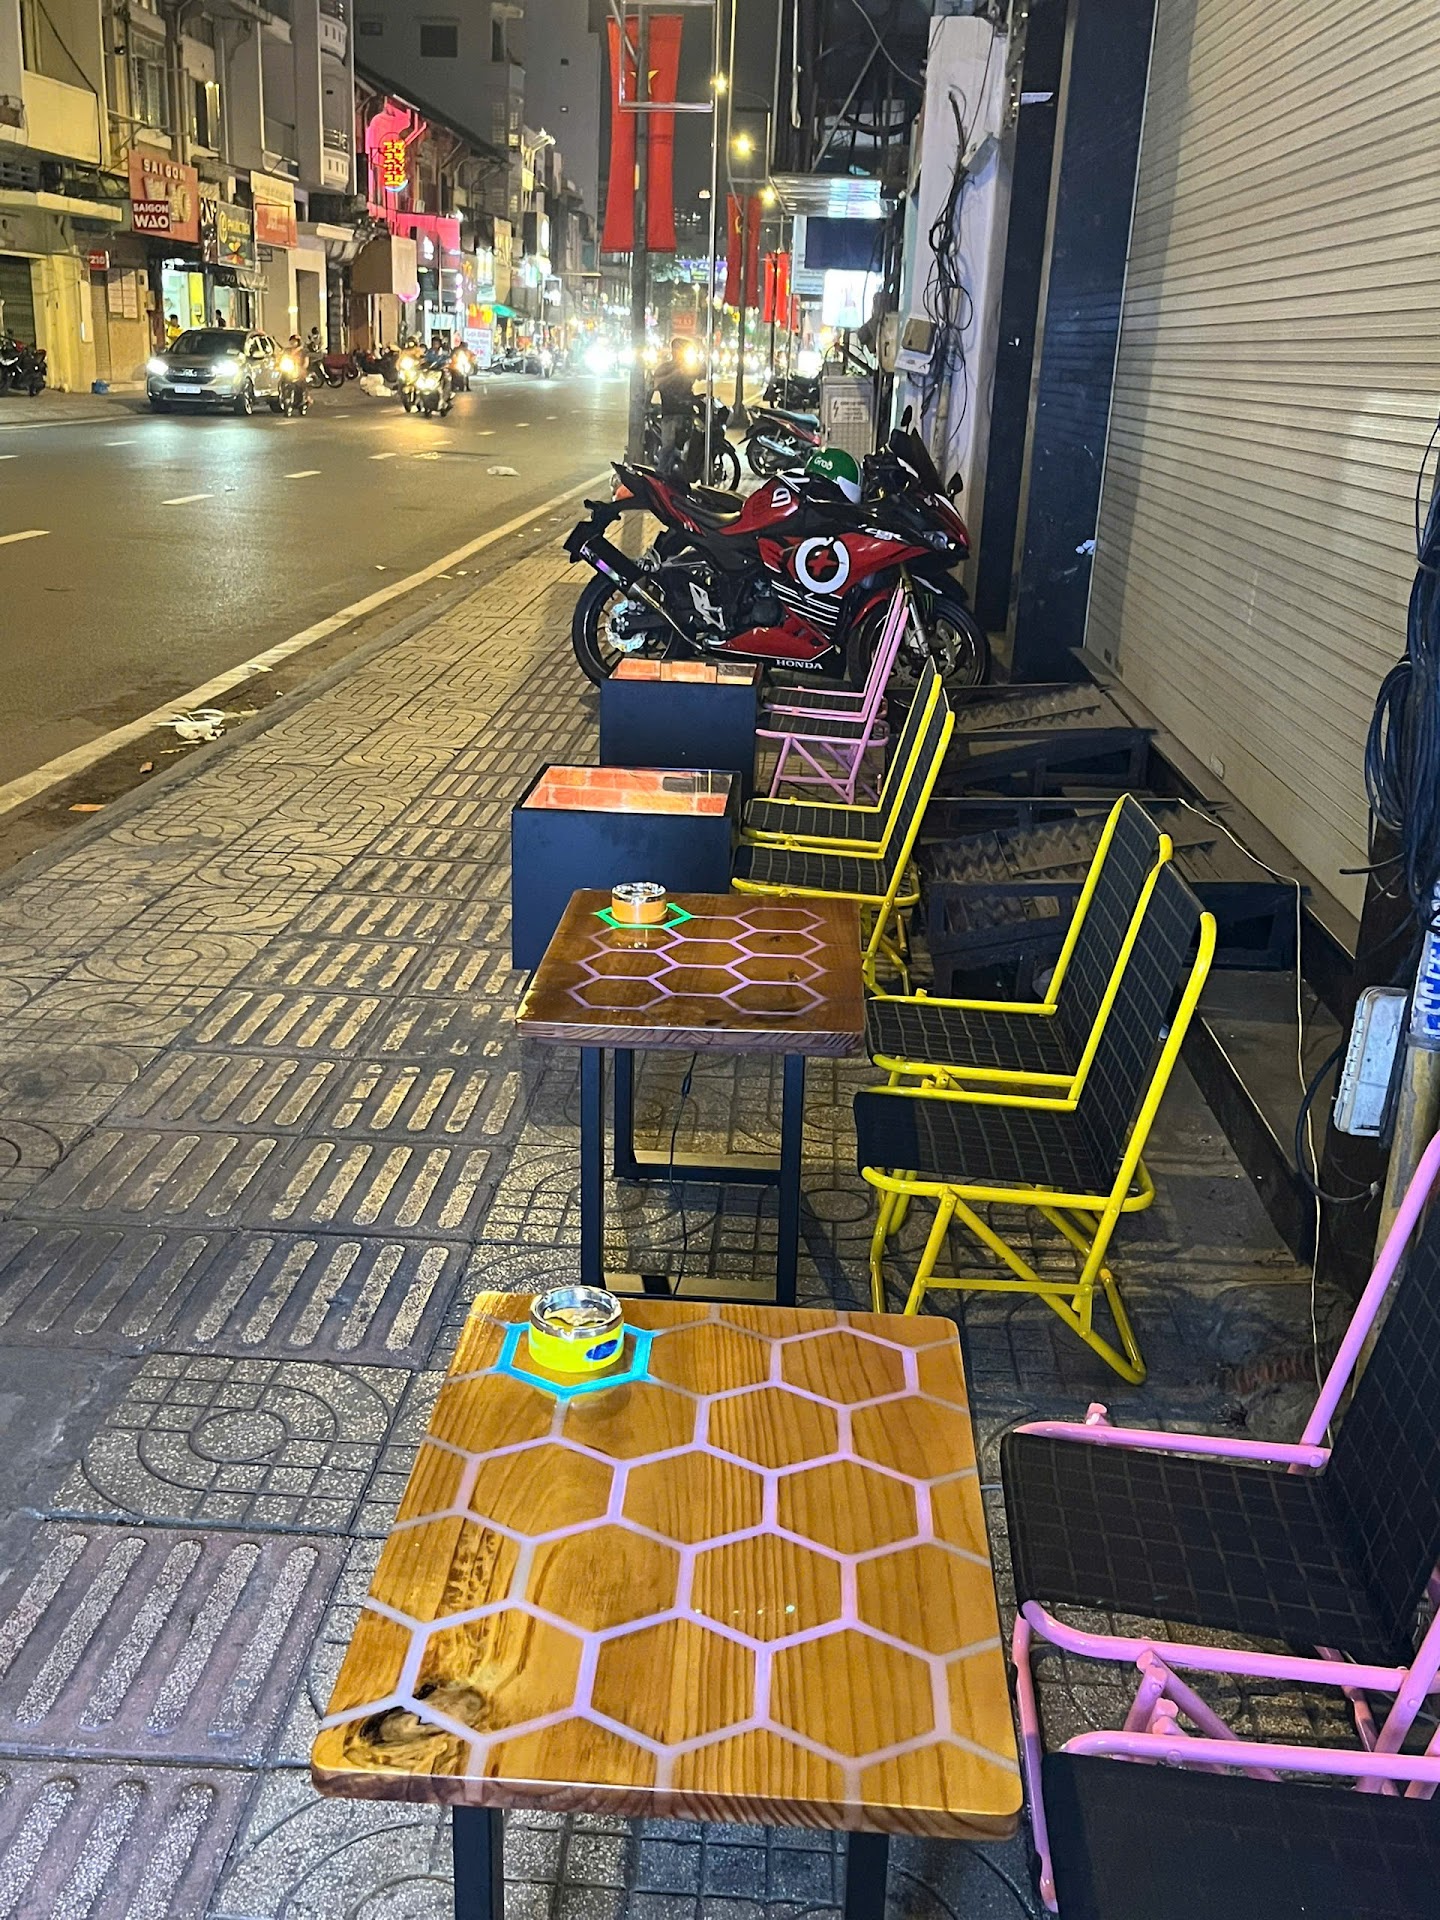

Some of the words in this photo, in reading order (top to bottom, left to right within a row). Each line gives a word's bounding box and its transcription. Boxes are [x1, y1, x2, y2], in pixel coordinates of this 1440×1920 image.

[143, 158, 185, 181] SAIGON
[133, 203, 169, 213] SAIGON
[814, 456, 833, 471] Grab
[776, 659, 824, 670] HONDA
